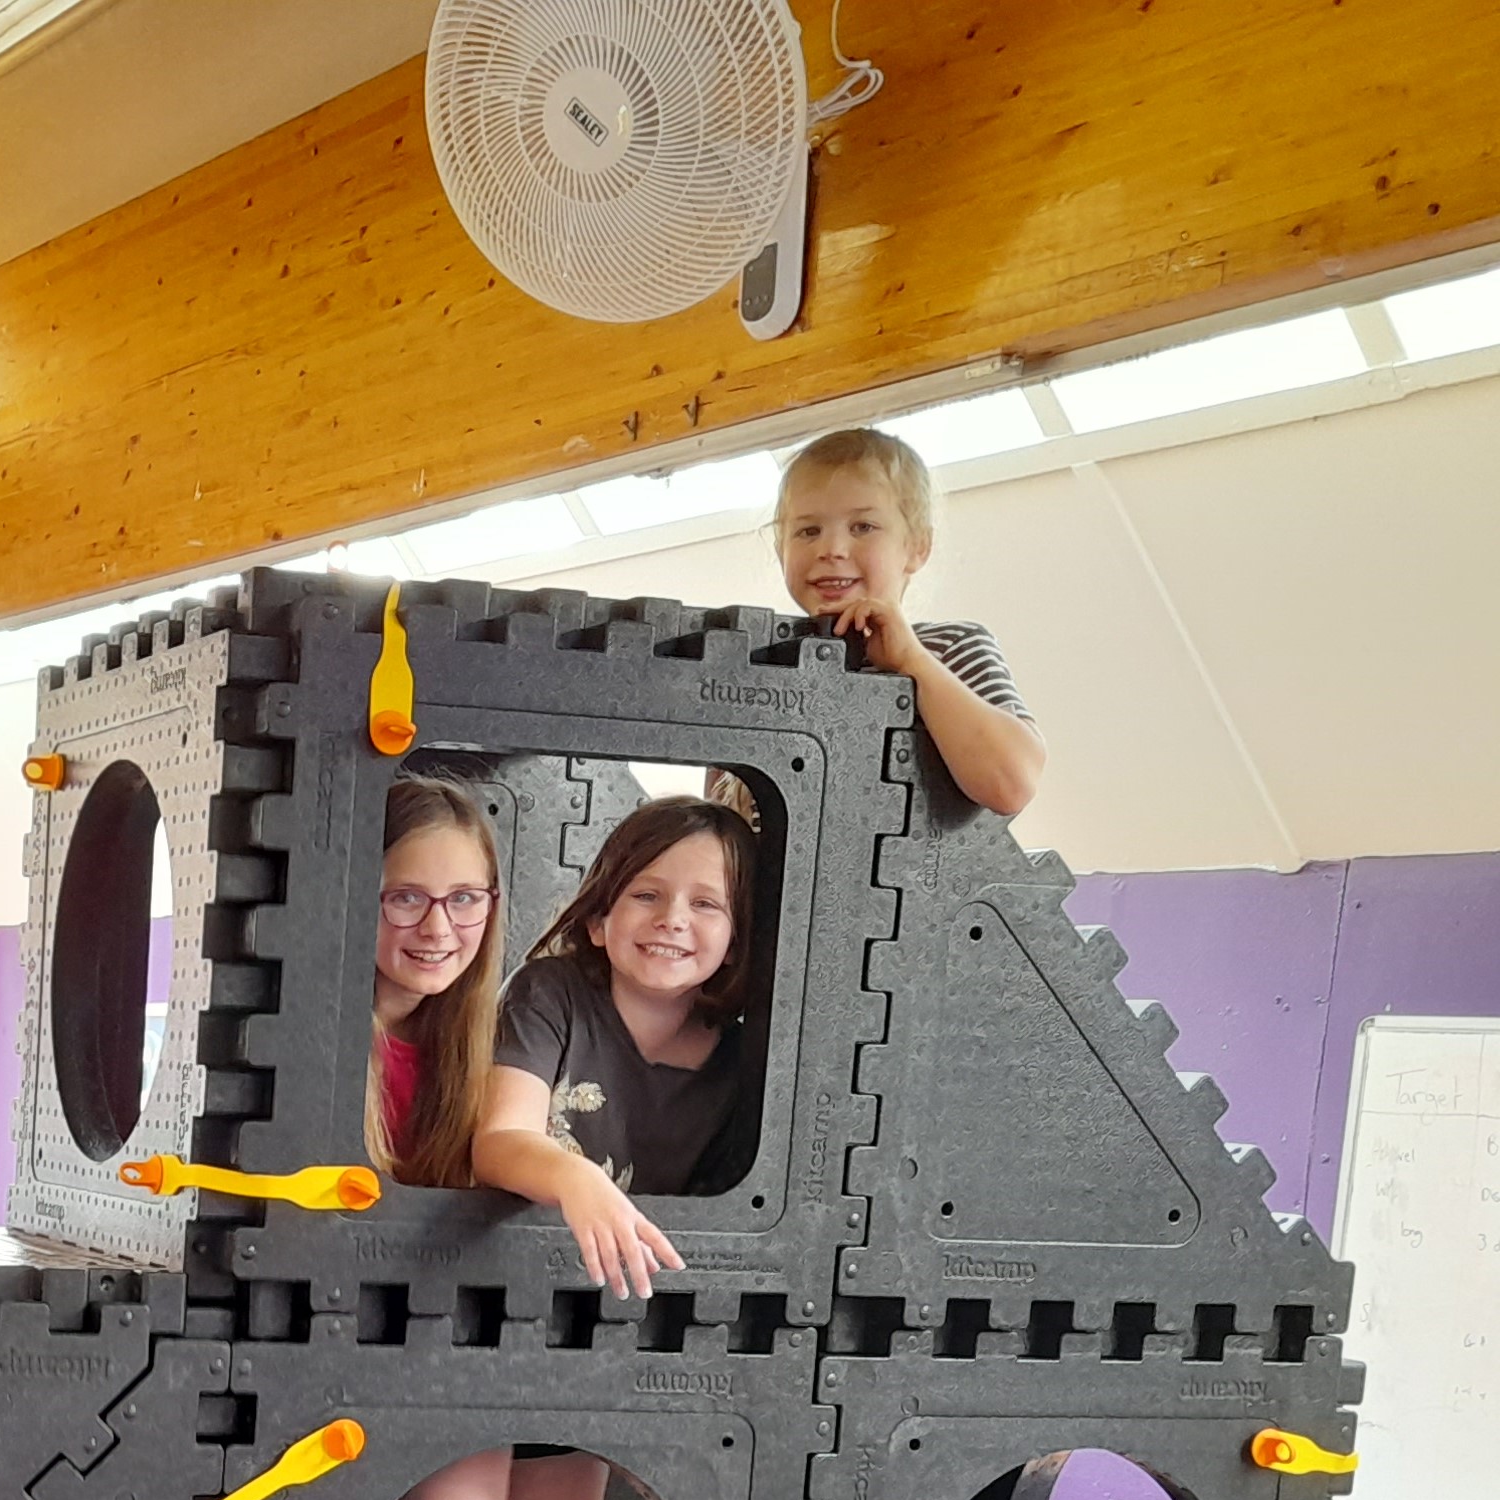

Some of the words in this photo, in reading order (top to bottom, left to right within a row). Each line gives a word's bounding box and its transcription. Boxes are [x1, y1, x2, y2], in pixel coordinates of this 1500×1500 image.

[569, 104, 604, 141] SEALEY
[700, 678, 805, 714] kitcamp
[1386, 1068, 1464, 1127] Target
[803, 1093, 834, 1204] kitcamp
[35, 1195, 66, 1223] kitcamp
